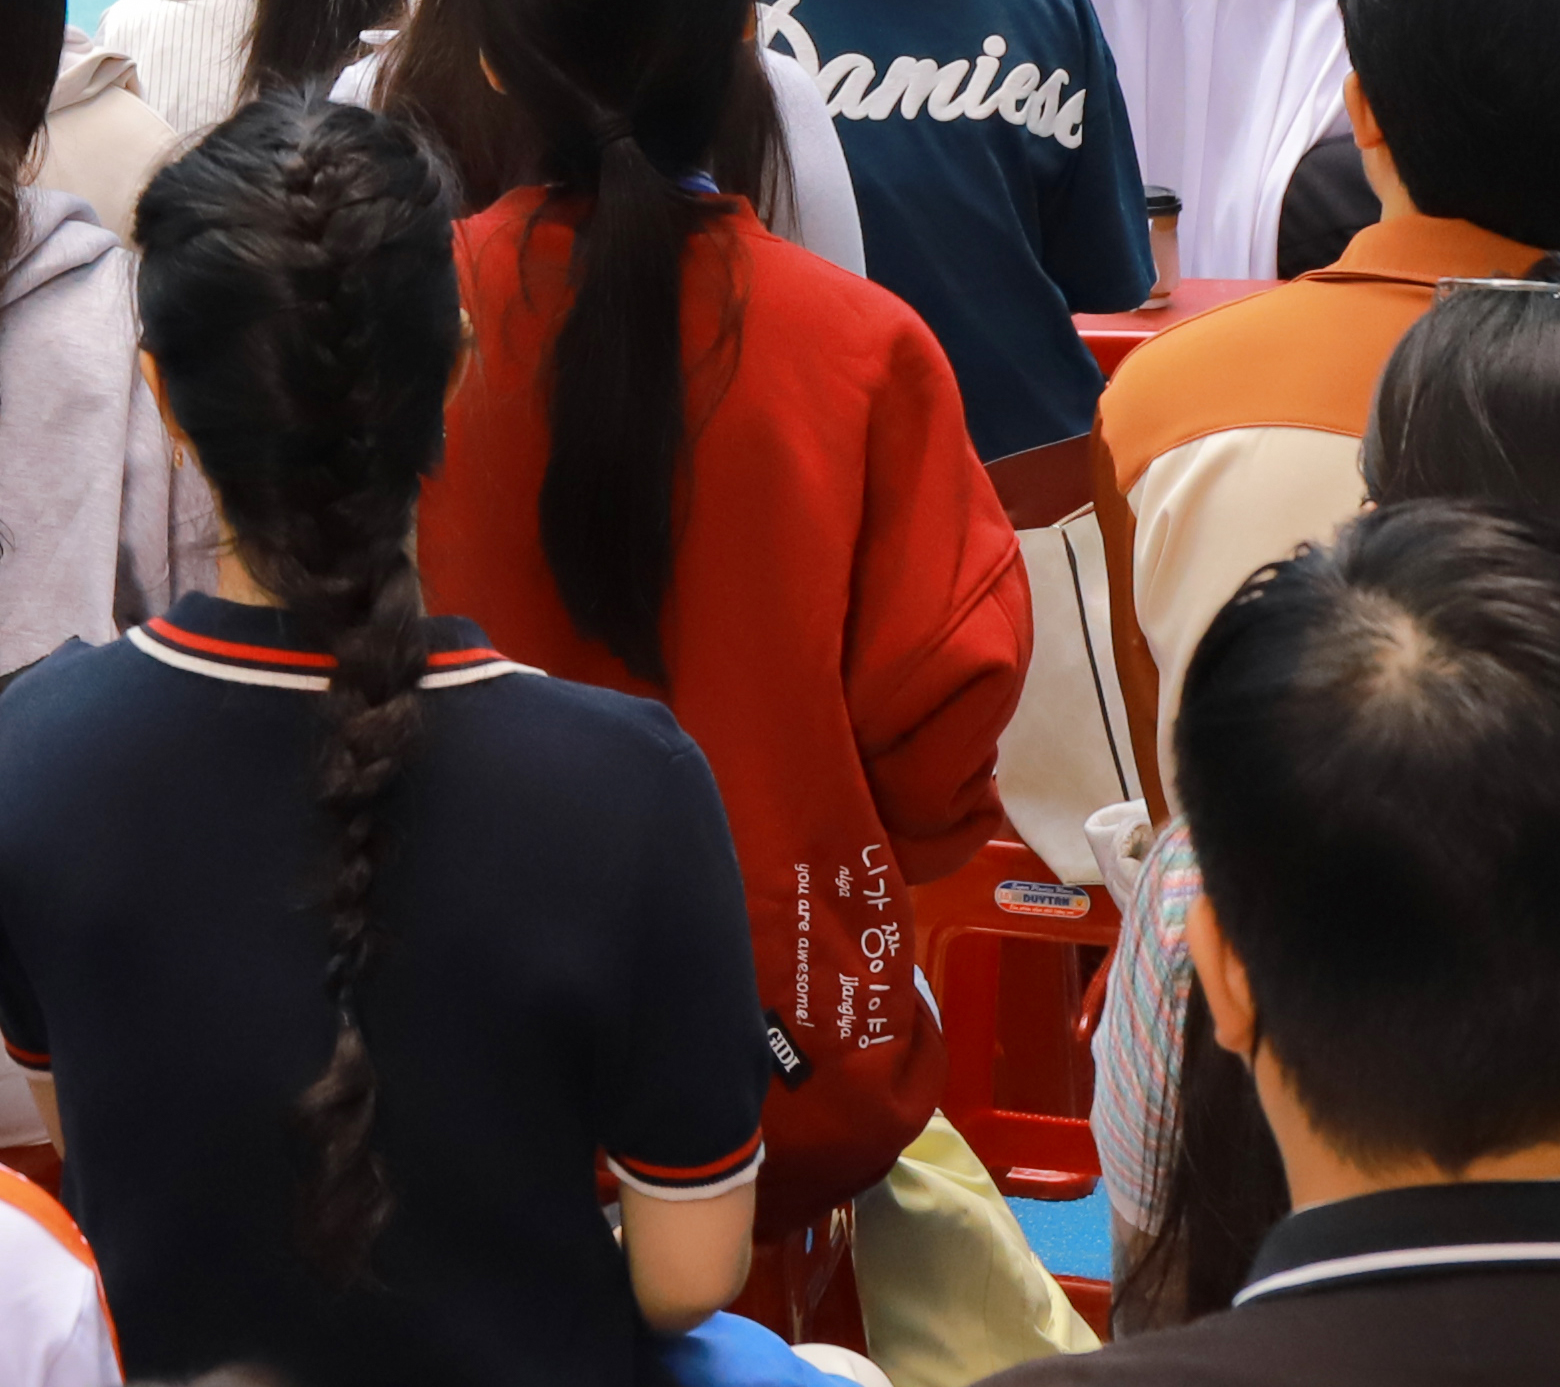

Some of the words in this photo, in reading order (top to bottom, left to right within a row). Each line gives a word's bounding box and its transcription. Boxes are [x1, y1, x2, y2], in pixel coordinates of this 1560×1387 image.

[794, 863, 811, 895] you
[861, 843, 892, 912] 니가
[797, 899, 811, 933] are
[794, 937, 816, 1029] awesome!
